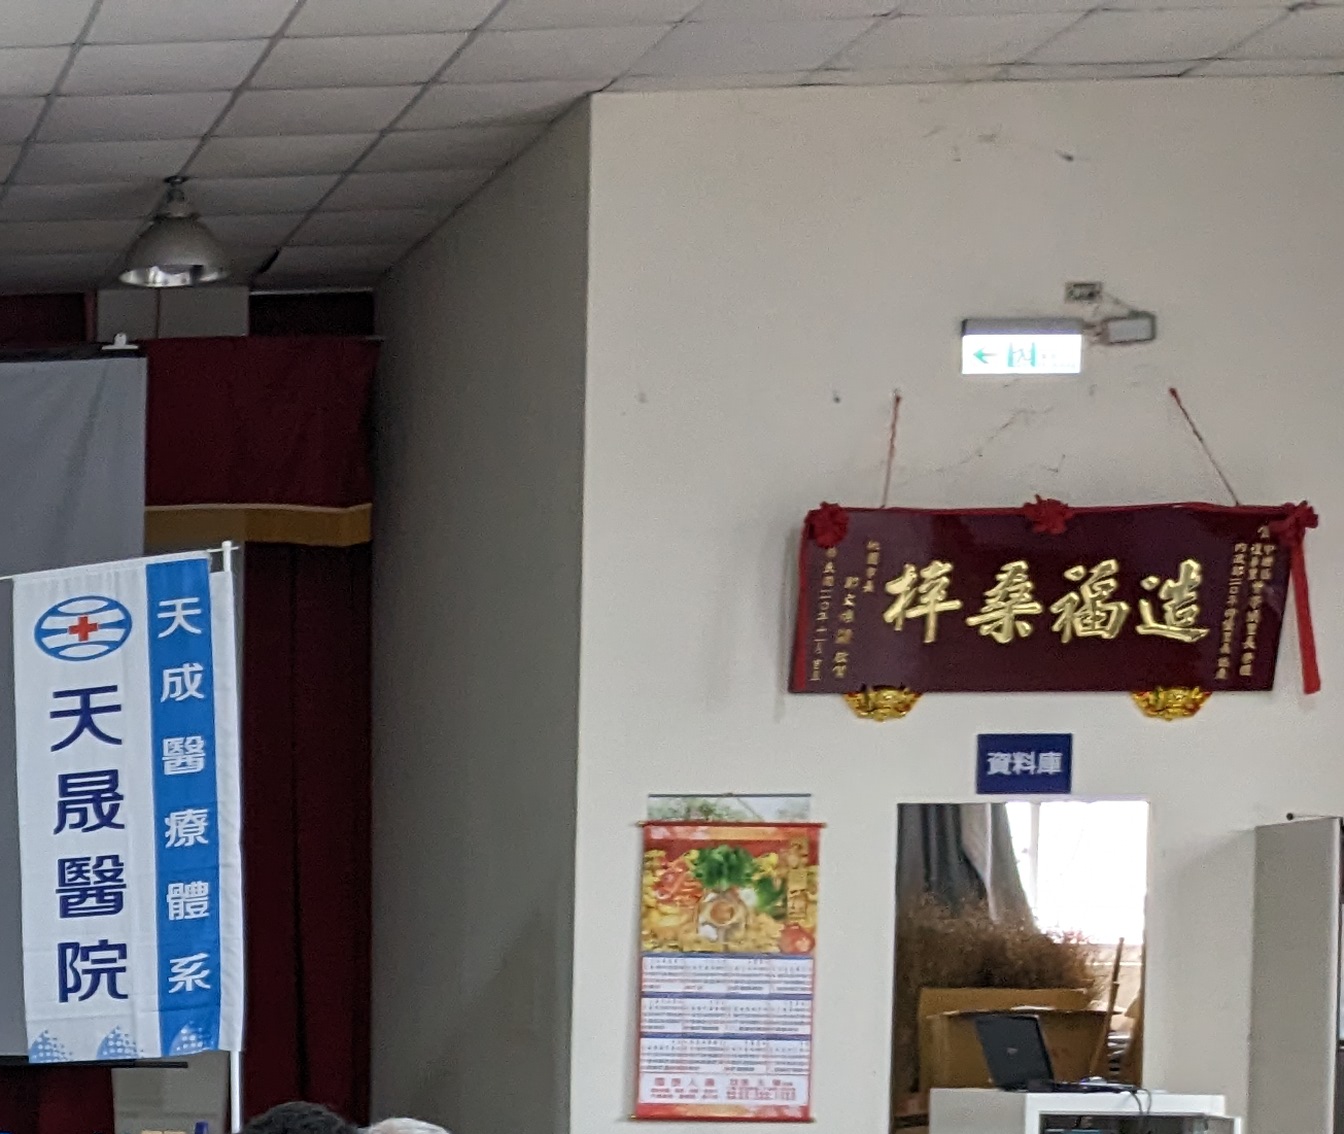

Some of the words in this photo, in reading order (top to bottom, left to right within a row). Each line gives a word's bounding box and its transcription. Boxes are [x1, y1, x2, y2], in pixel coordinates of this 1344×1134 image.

[49, 684, 128, 1003] 天晟醫院
[156, 597, 211, 994] 天成醫療體系
[987, 751, 1062, 775] 資料庫
